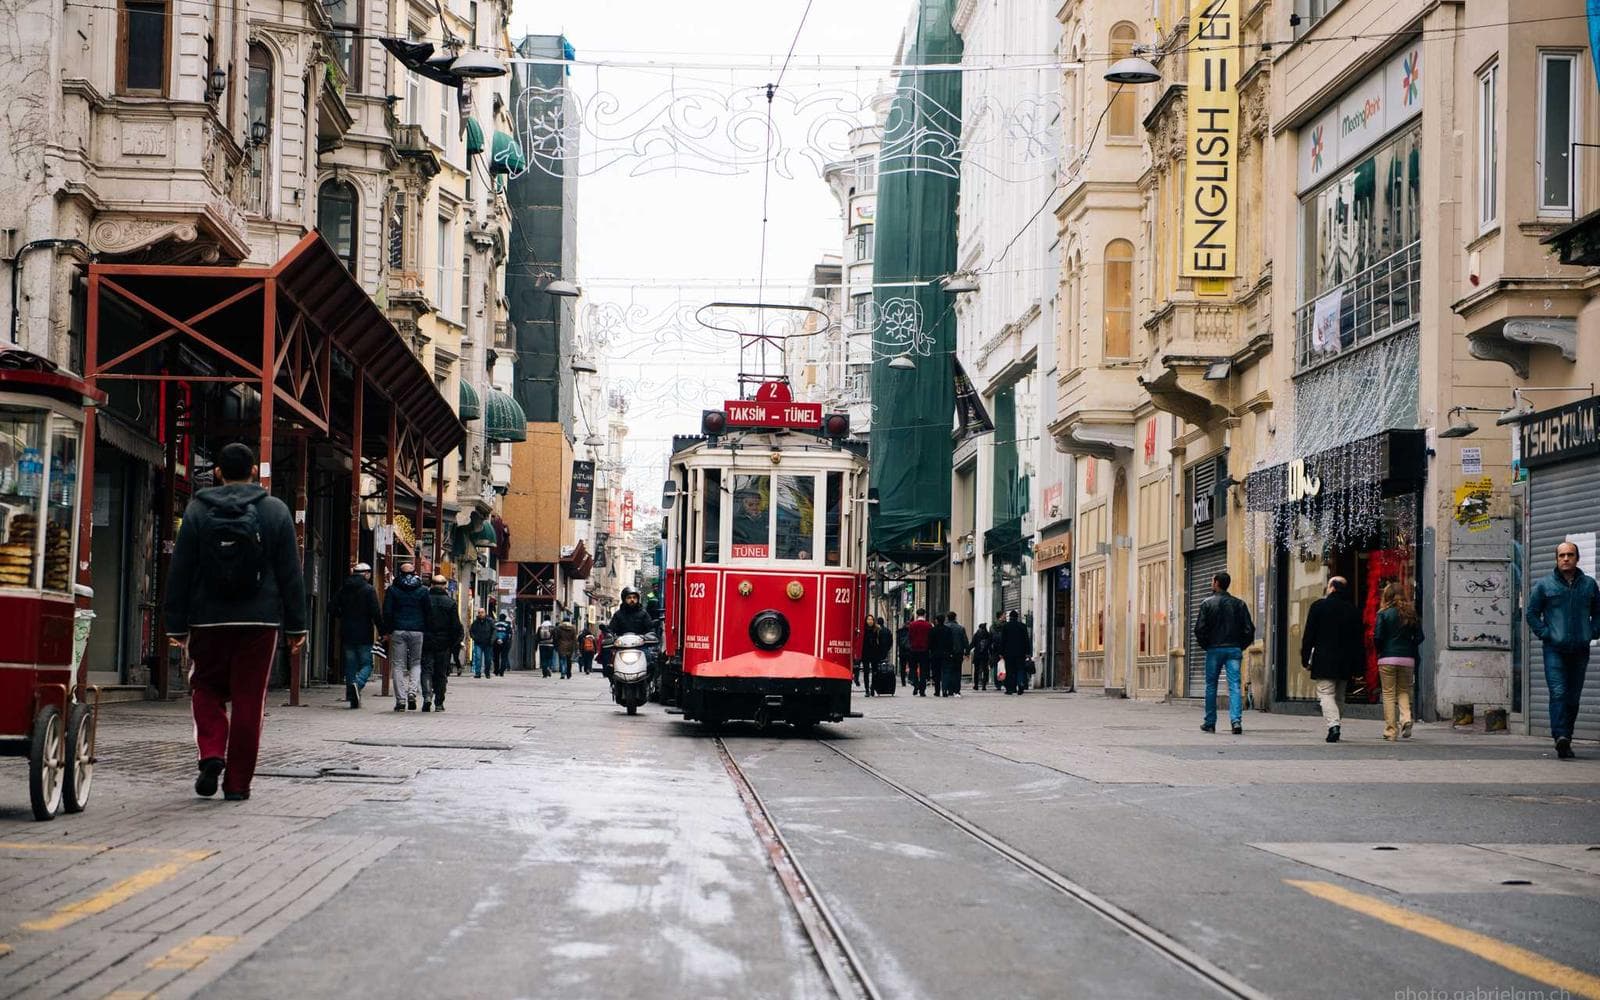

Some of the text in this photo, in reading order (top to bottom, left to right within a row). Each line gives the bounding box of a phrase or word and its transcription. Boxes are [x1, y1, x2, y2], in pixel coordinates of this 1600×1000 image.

[1194, 108, 1229, 271] ENGLISH
[769, 382, 778, 398] 2
[729, 405, 766, 422] TAKSİM
[784, 407, 818, 423] TÜNEL
[690, 583, 706, 598] 223
[835, 588, 851, 604] 223
